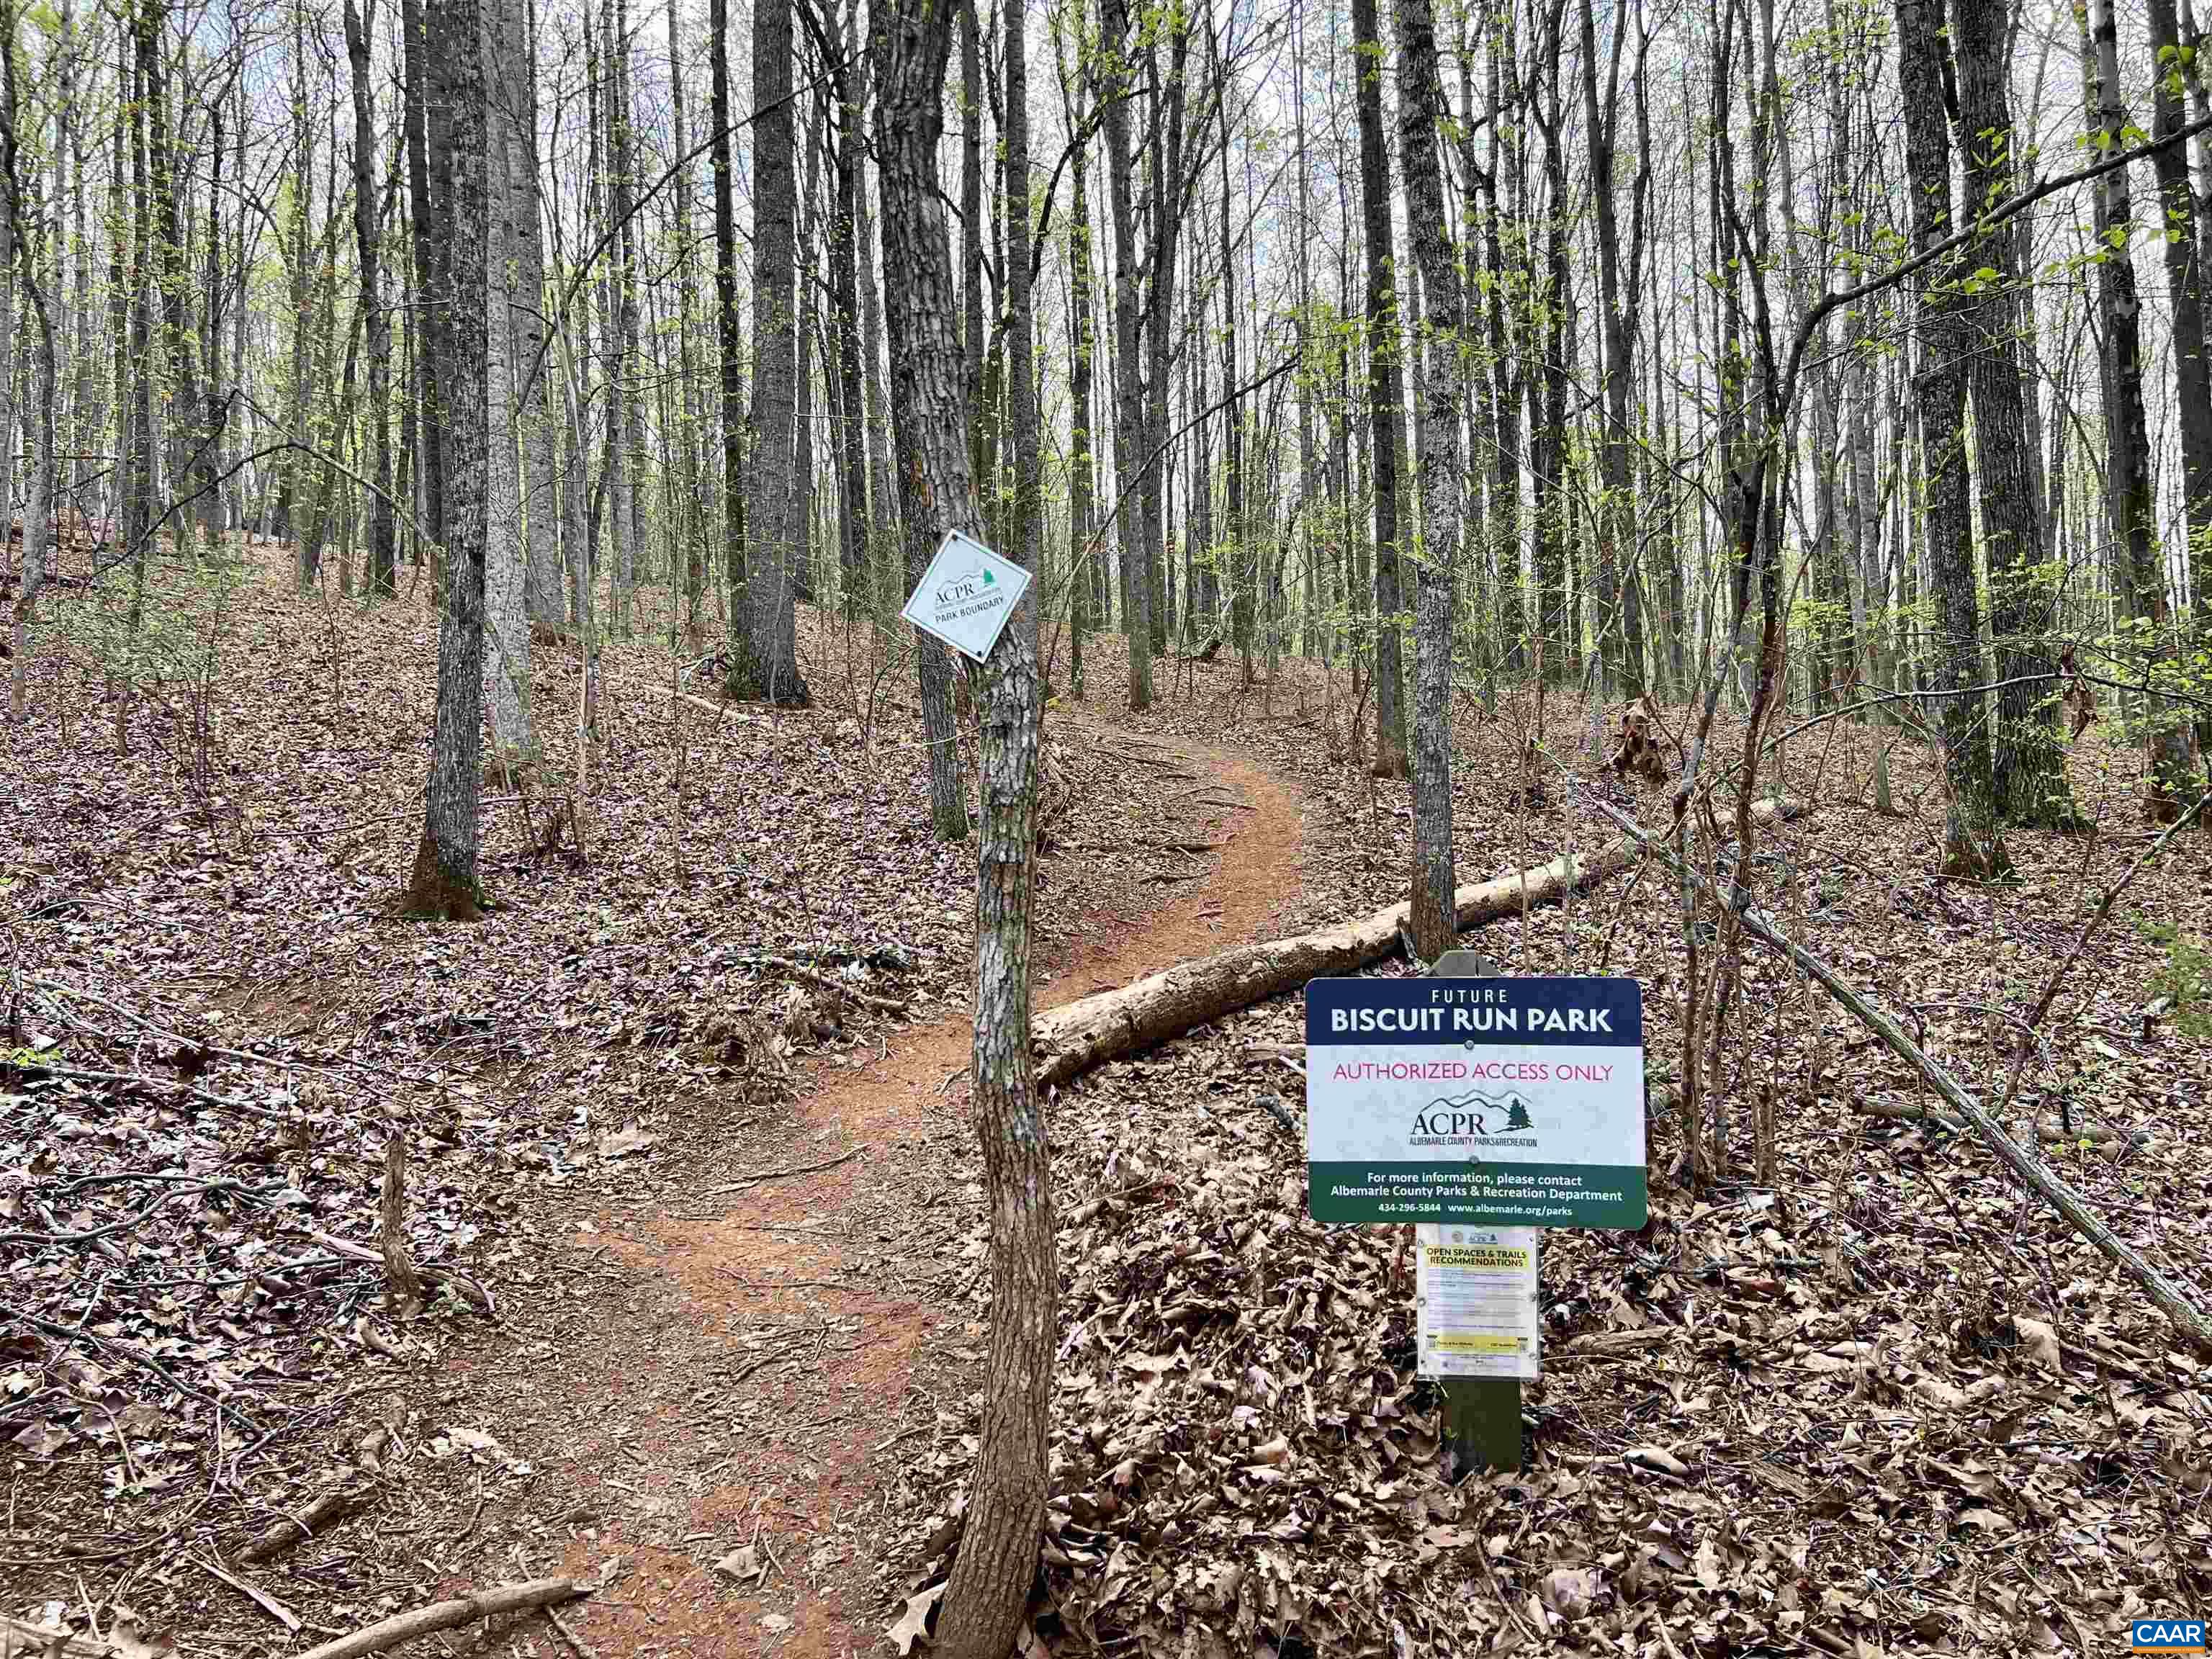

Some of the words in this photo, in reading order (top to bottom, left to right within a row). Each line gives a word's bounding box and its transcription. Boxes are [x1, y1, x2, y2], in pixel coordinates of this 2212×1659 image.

[937, 583, 974, 603] ACPR
[935, 611, 958, 623] PARK
[960, 594, 1003, 617] BOUNDARY
[1431, 989, 1508, 1003] FUTURE
[1331, 1008, 1444, 1032] BISCUIT
[1453, 1008, 1516, 1031] RUN
[1527, 1009, 1613, 1032] PARK
[1333, 1063, 1467, 1080] AUTHORIZED
[1472, 1064, 1549, 1080] ACCESS
[1555, 1065, 1614, 1081] ONLY
[1411, 1112, 1487, 1136] ACPR
[1409, 1136, 1447, 1146] ALBEMARLE
[1447, 1137, 1472, 1146] COUNTY
[1367, 1172, 1387, 1183] For
[1389, 1174, 1419, 1183] more
[1422, 1172, 1493, 1184] information,
[1497, 1173, 1534, 1186] please
[1538, 1175, 1583, 1186] contact
[1331, 1184, 1390, 1197] Albemarle
[1393, 1185, 1433, 1198] County
[1436, 1186, 1467, 1197] Parks
[1470, 1186, 1480, 1197] &
[1483, 1186, 1546, 1198] Recreation
[1549, 1188, 1623, 1202] Department
[1378, 1203, 1441, 1213] 434-296-5844
[1447, 1204, 1573, 1216] www.albemarle.org/parks
[1427, 1247, 1452, 1256] OPEN
[1453, 1249, 1486, 1257] SPACES
[1496, 1250, 1527, 1259] TRAILS
[1430, 1256, 1524, 1267] RECOMMENDATIONS
